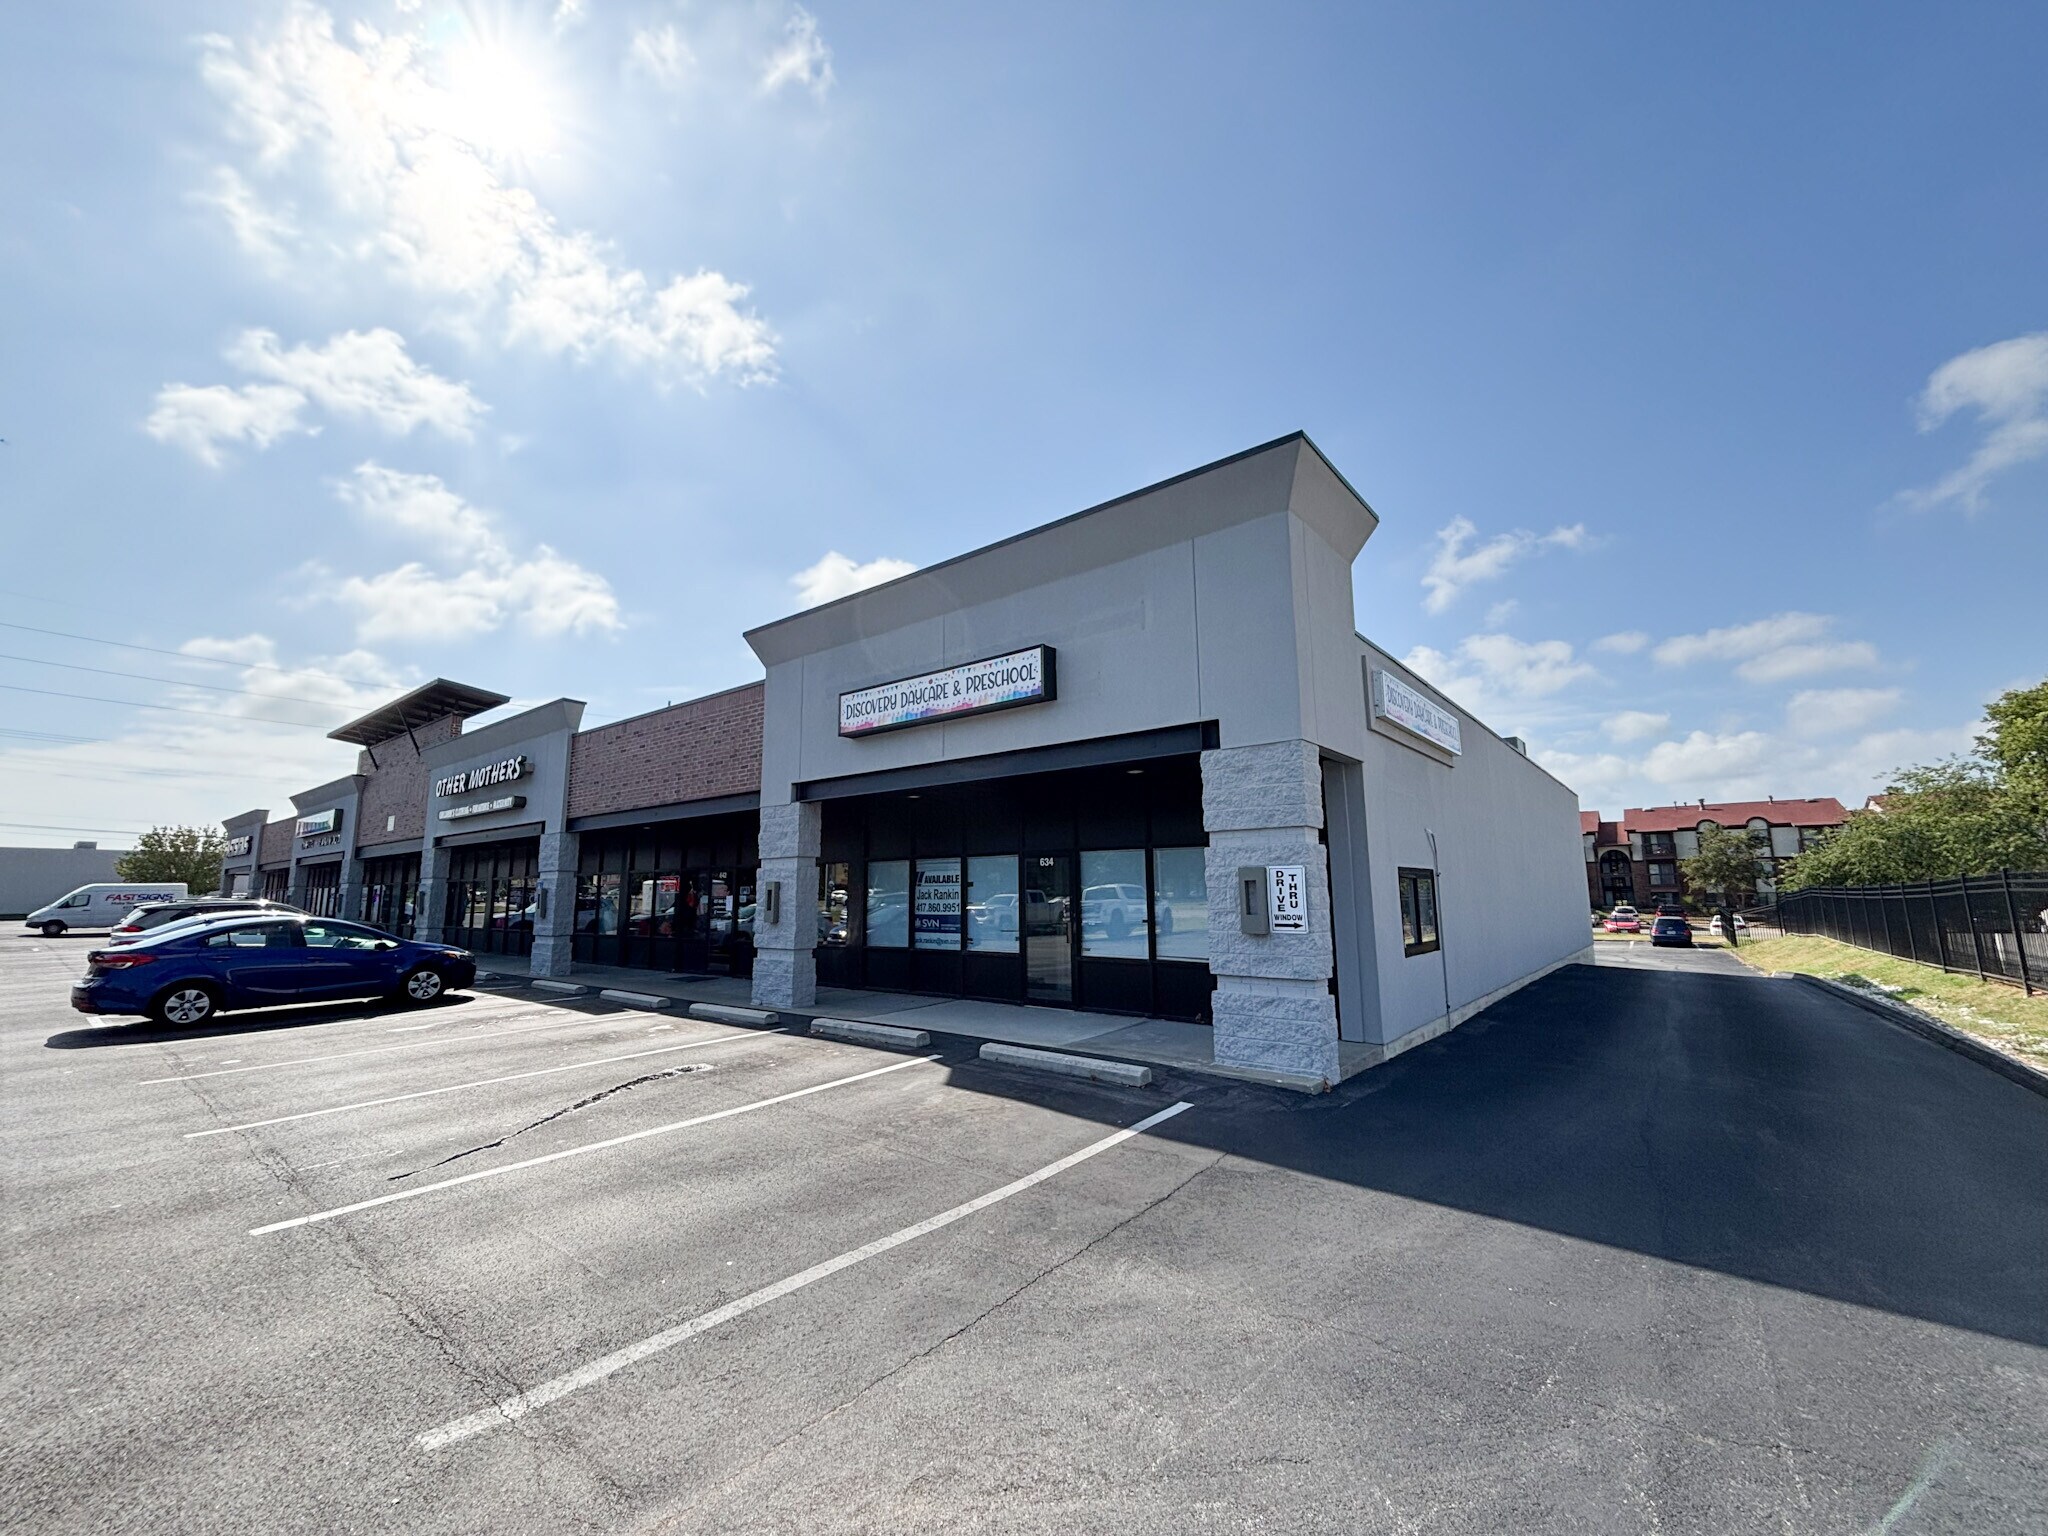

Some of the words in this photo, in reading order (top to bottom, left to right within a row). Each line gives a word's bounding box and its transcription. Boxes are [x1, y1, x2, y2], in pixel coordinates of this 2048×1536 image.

[845, 694, 898, 720] DISCOVERY
[900, 682, 950, 709] DAYCARE
[952, 680, 962, 696] &
[965, 663, 1036, 695] PRESCHOOL
[435, 772, 466, 797] OTHER
[468, 755, 522, 789] MOTHERS
[1039, 857, 1055, 866] 634
[924, 874, 960, 884] AVAILABLE
[917, 889, 932, 900] Jack
[933, 888, 960, 900] Rankin
[1275, 870, 1286, 912] DRIVE
[1288, 874, 1299, 909] THRU
[104, 893, 175, 901] FASTSIGNS
[916, 902, 960, 913] 417.860.9951
[922, 919, 940, 928] SVN
